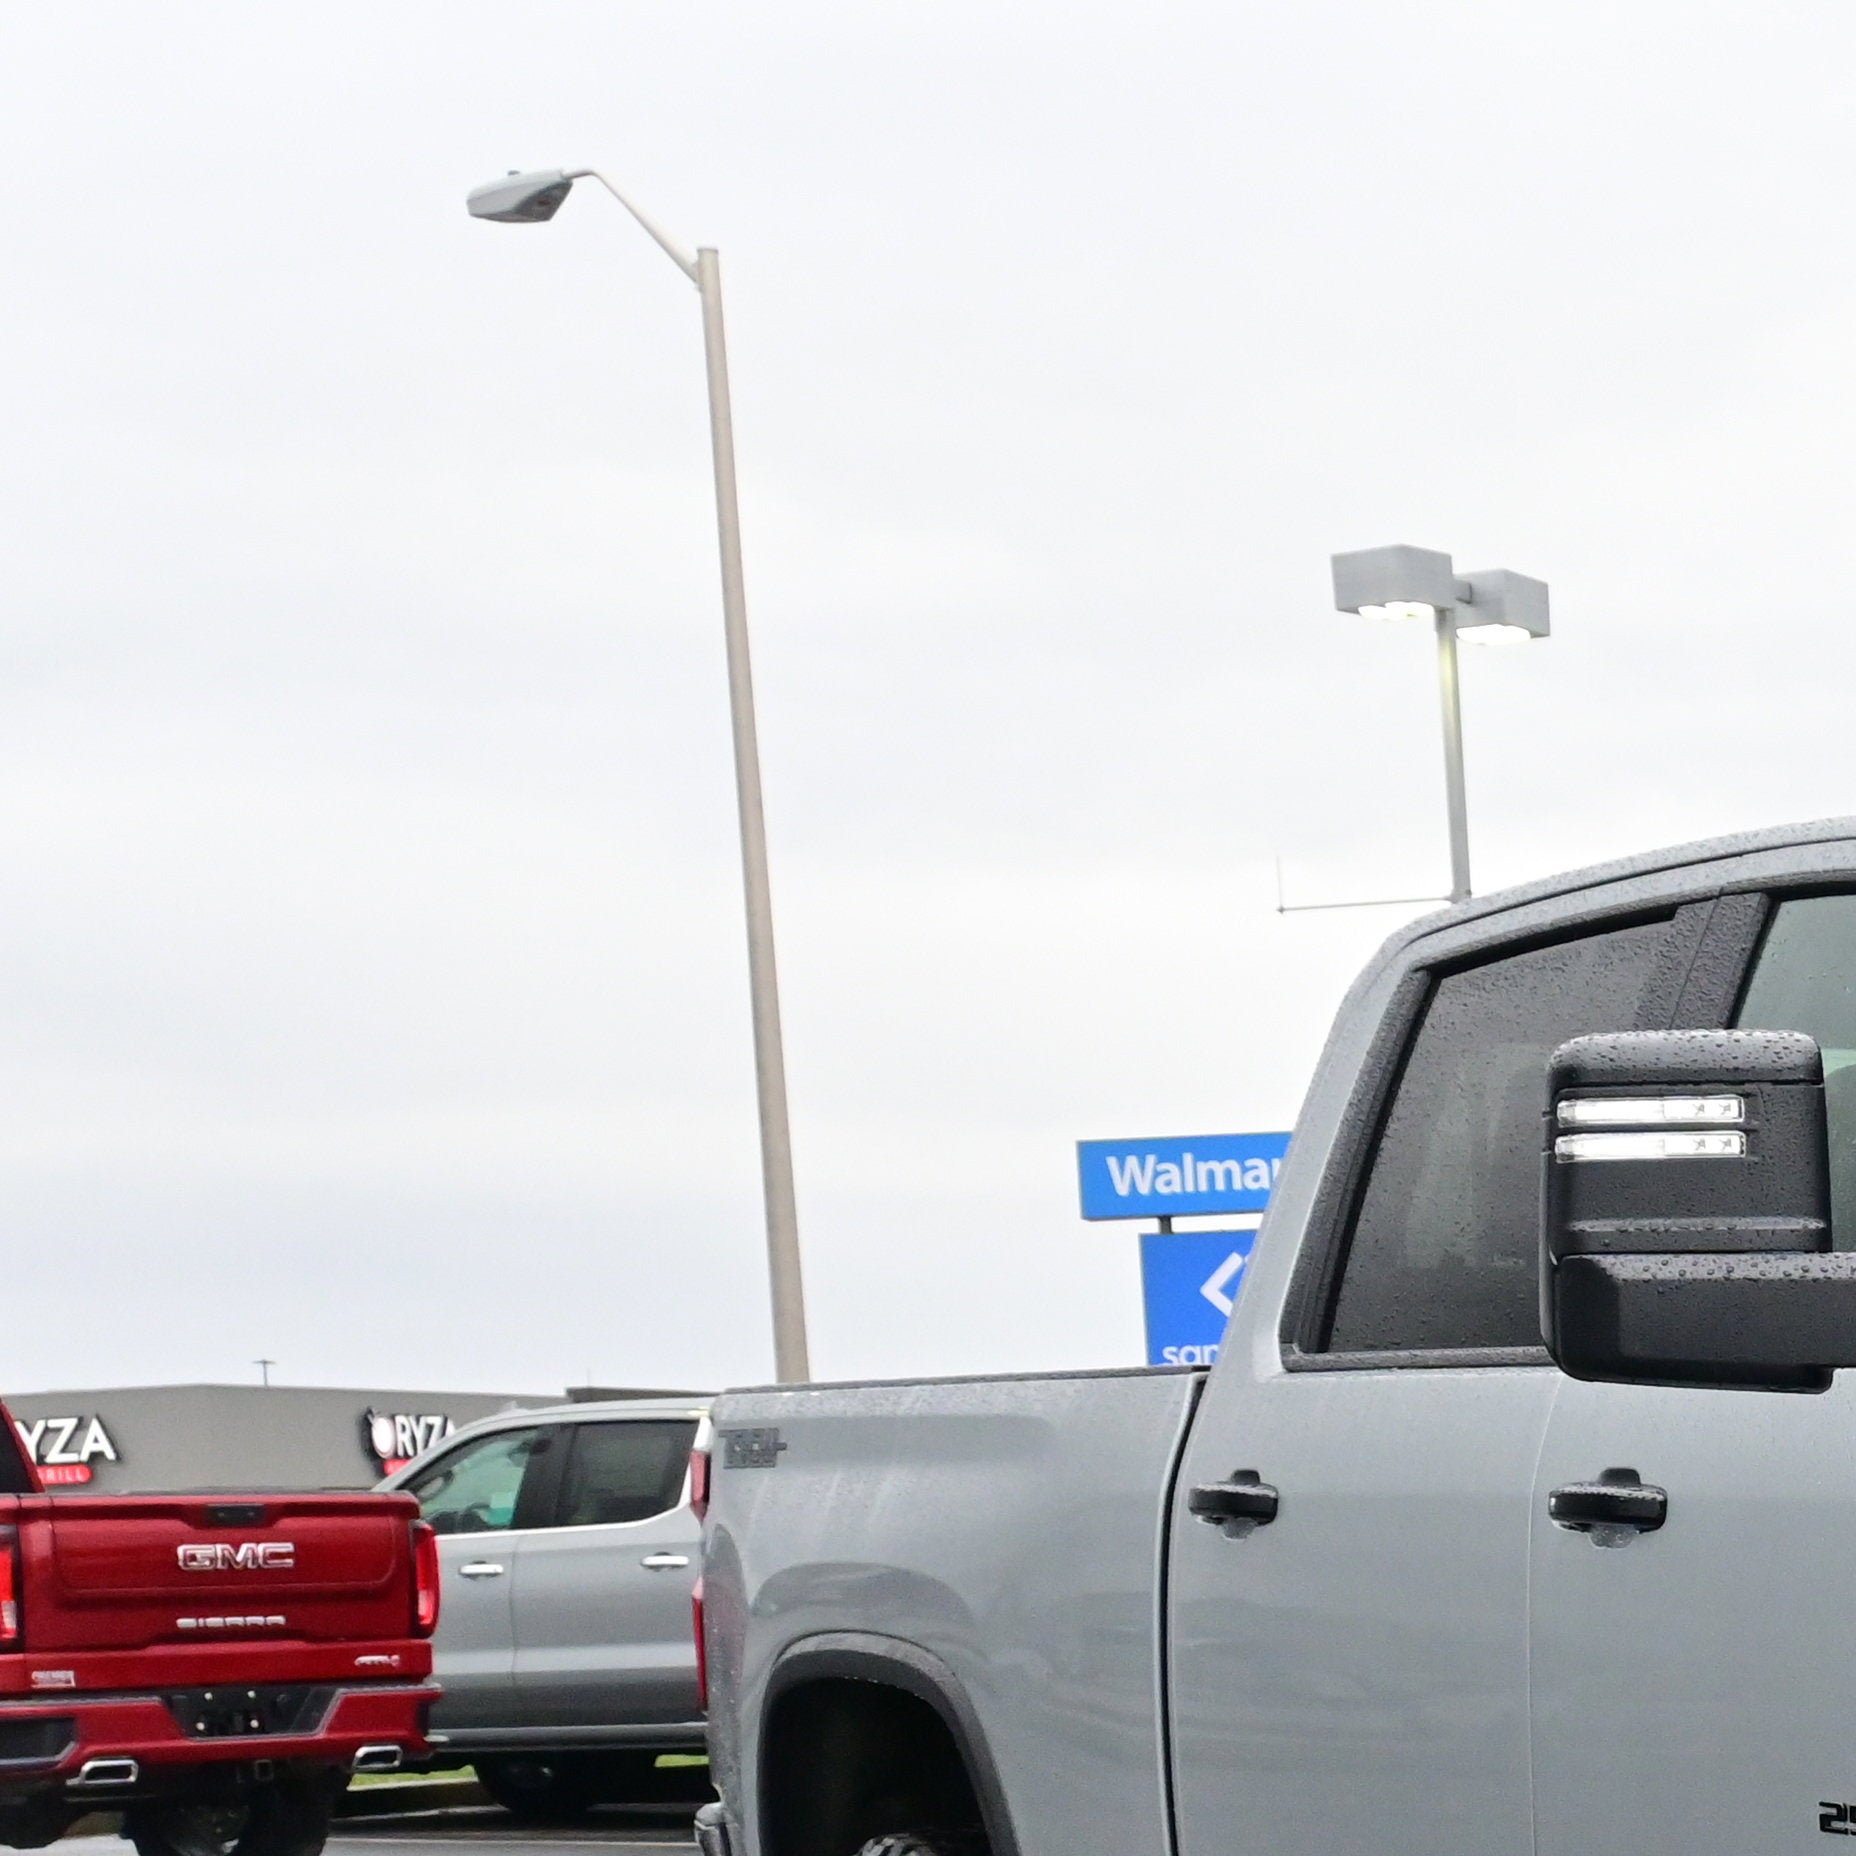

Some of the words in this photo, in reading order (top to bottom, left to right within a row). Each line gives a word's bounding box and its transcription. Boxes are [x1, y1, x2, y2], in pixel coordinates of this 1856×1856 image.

[1106, 1152, 1281, 1197] Walma
[14, 1417, 117, 1463] YZA
[38, 1468, 85, 1483] RILL
[177, 1542, 295, 1571] GMC
